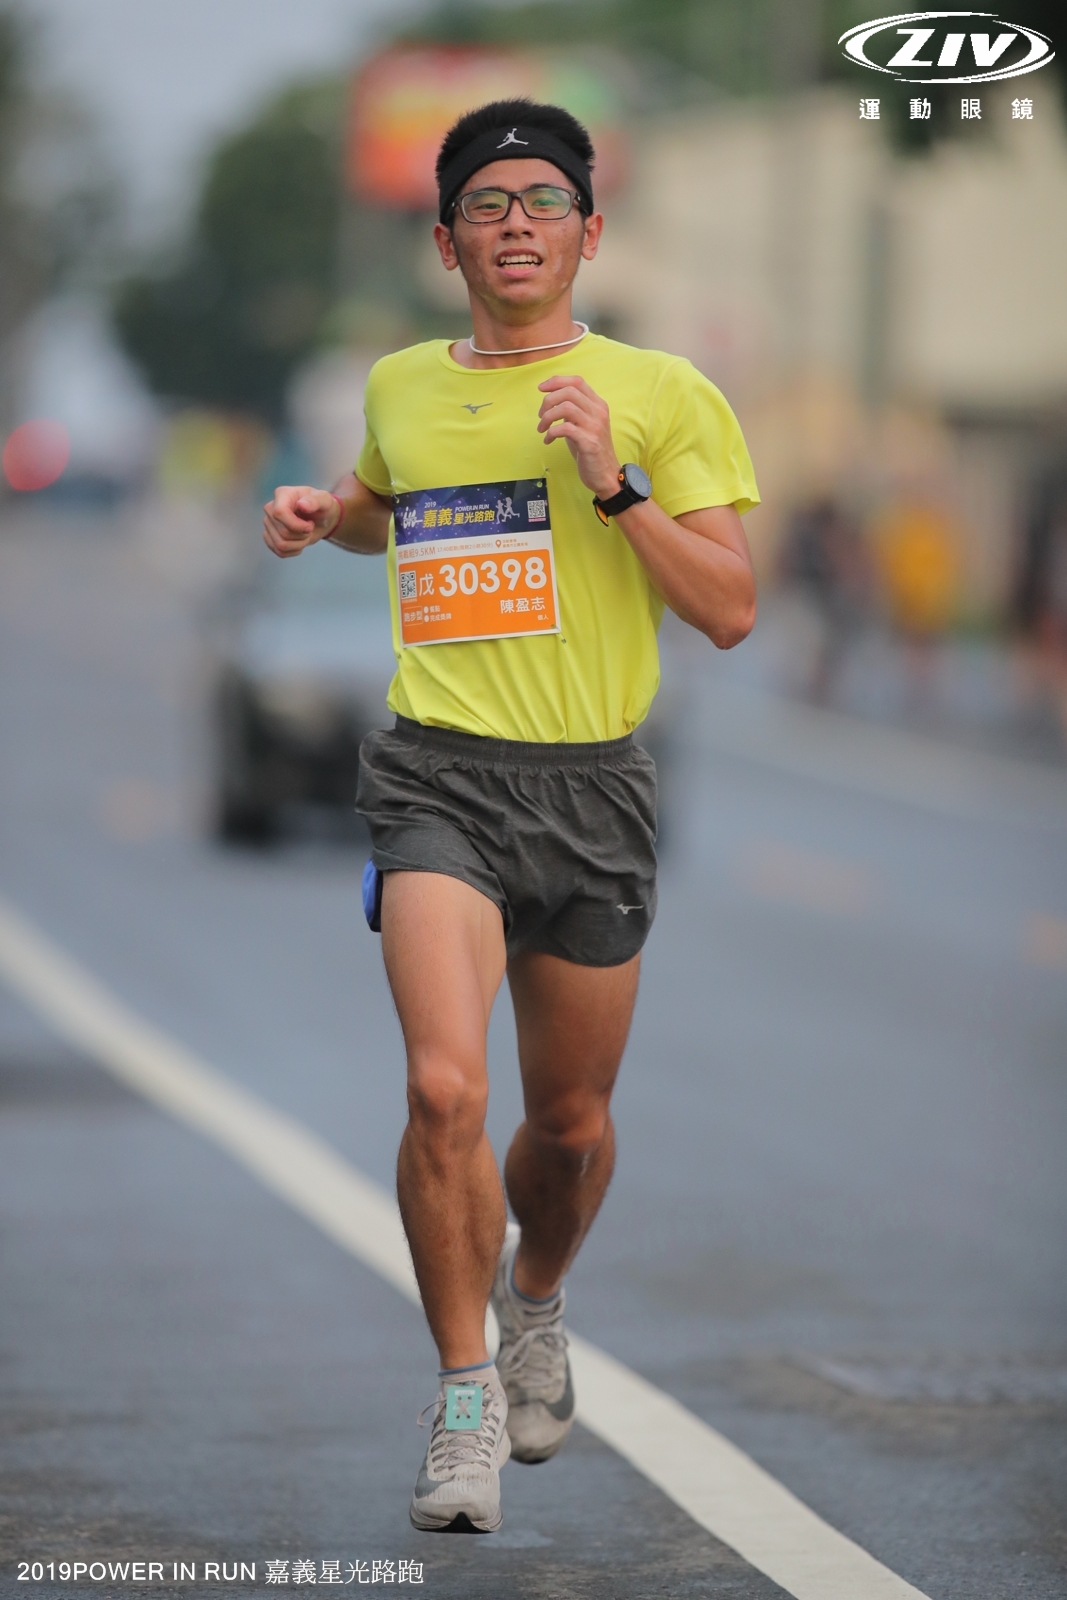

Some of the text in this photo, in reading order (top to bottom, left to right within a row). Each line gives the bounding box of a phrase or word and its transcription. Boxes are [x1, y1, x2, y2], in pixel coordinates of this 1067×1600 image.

[424, 501, 437, 509] 2019
[455, 505, 473, 513] POWER
[478, 503, 490, 511] RUN
[418, 556, 548, 597] 戊 30398
[500, 596, 546, 614] 陳盈志
